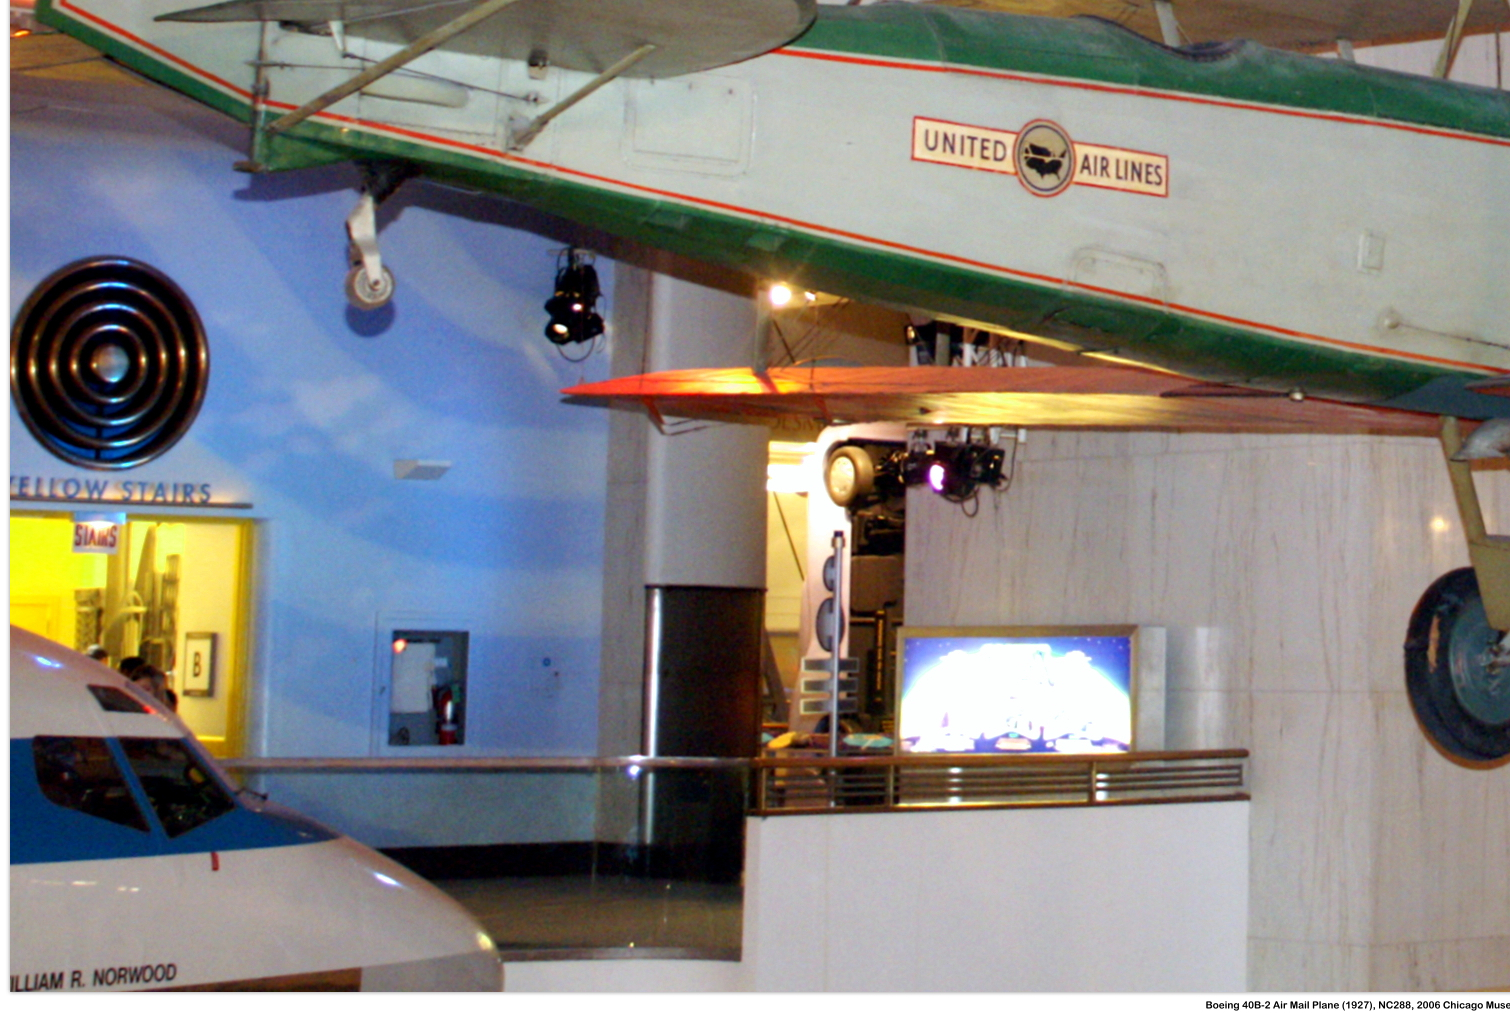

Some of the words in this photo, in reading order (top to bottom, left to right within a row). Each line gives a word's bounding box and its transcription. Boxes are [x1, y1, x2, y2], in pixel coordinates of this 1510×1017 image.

[924, 128, 1007, 163] UNITED
[1080, 153, 1110, 179] AIR
[1115, 158, 1163, 187] LINES
[122, 480, 212, 504] STAIRS
[193, 650, 202, 678] B
[70, 970, 85, 988] R.
[92, 963, 177, 987] NORWOOD
